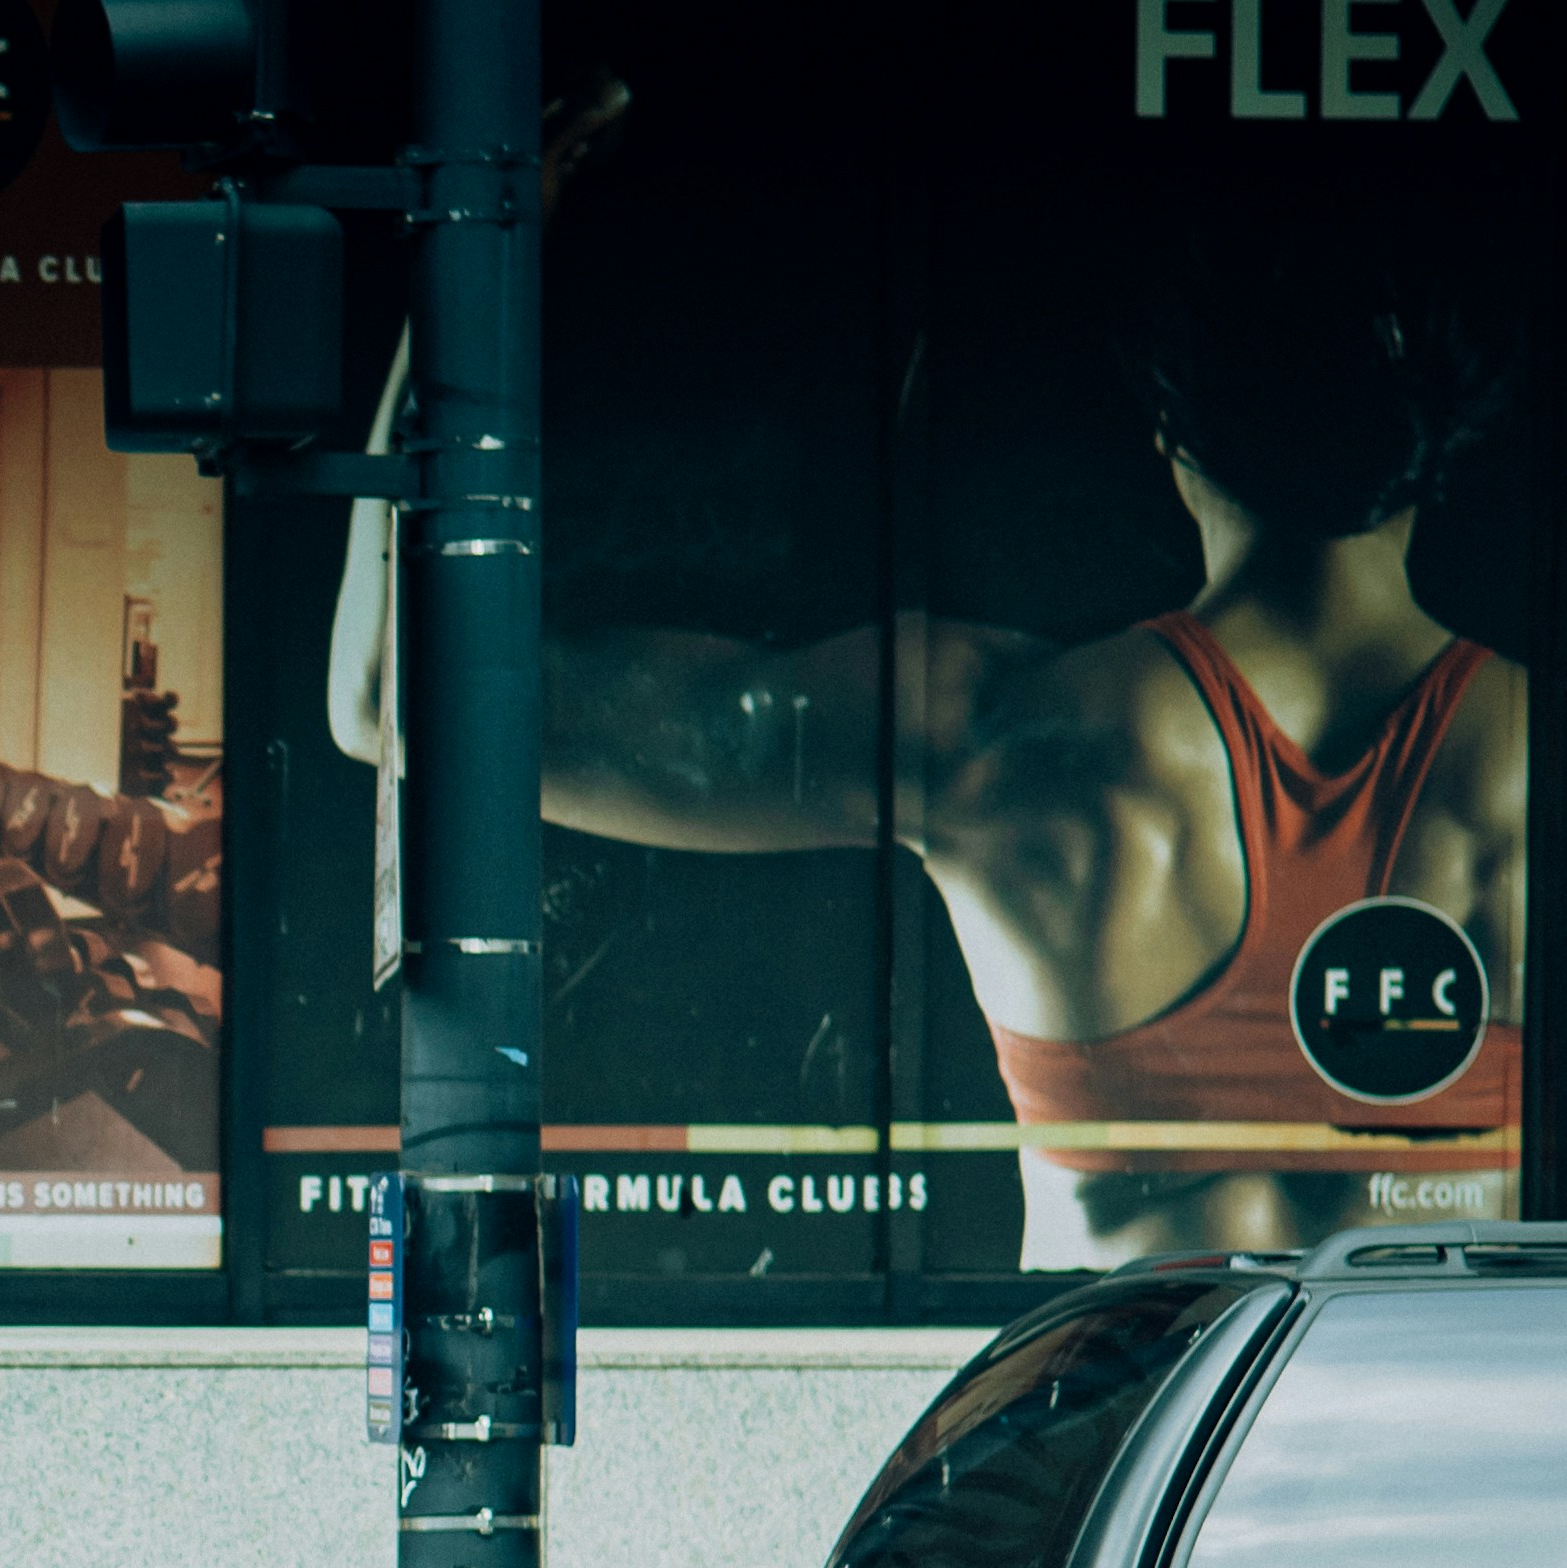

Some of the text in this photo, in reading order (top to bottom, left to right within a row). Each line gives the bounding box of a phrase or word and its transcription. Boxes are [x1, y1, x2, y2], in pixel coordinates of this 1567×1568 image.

[1135, 0, 1521, 120] FLEX
[38, 254, 102, 283] CLU
[33, 1181, 206, 1208] SOMETHING
[583, 1173, 747, 1214] RMULA
[1369, 1172, 1484, 1216] ffc.com
